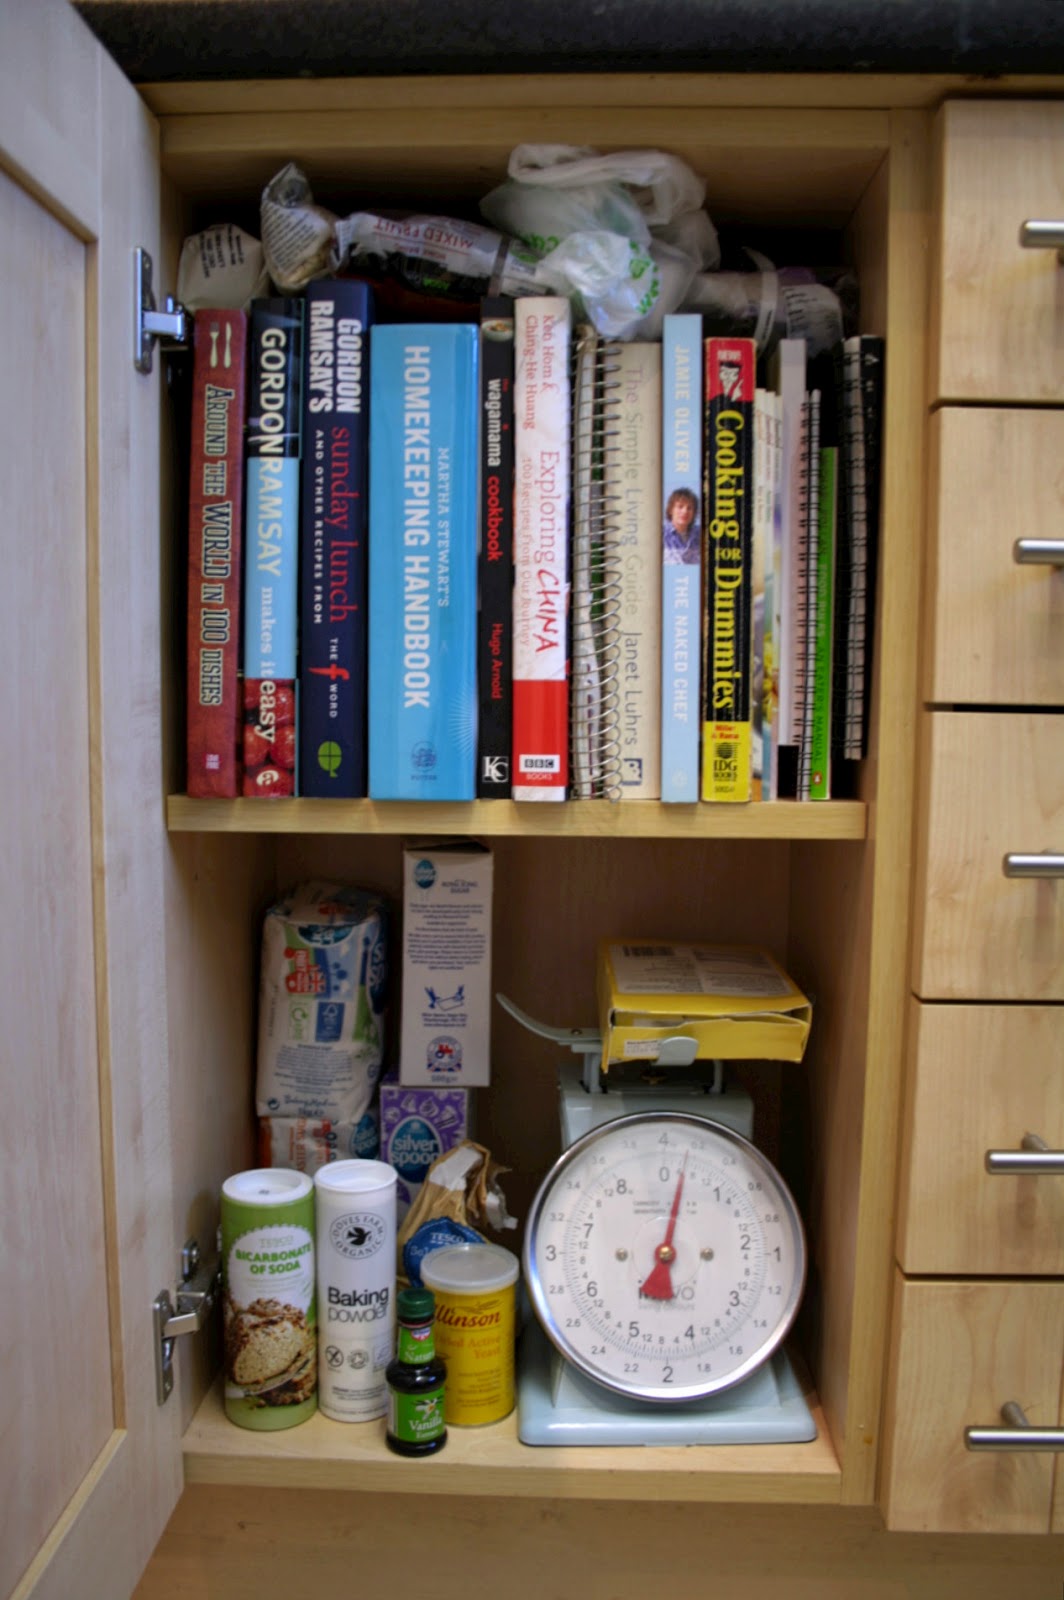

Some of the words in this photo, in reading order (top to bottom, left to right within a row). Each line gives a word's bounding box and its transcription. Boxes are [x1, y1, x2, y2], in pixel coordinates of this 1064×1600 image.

[423, 226, 472, 249] MIXED
[543, 314, 556, 341] Ken
[309, 301, 334, 413] RAMSAY'S
[524, 315, 539, 378] Ching-He
[336, 318, 362, 412] GORDON
[543, 346, 555, 378] Hom
[674, 344, 690, 400] JAMIE
[259, 328, 286, 454] GORDON
[625, 367, 643, 403] The
[523, 384, 538, 430] Huang
[485, 379, 502, 466] wagamama
[315, 429, 324, 460] AND
[404, 346, 431, 546] HOMEKEEPING
[621, 412, 643, 479] Simple
[675, 407, 690, 473] OLIVER
[203, 461, 227, 496] THE
[324, 426, 360, 528] sunday
[437, 448, 450, 514] MARTHA
[709, 409, 745, 540] Cooking
[315, 466, 324, 514] OTHER
[257, 458, 283, 576] RAMSAY
[487, 476, 503, 561] cookbook
[534, 451, 561, 564] Exploring
[621, 488, 643, 547] Living
[201, 501, 233, 578] WORLD
[314, 520, 323, 579] RECIPES
[437, 520, 449, 607] STEWART'S
[715, 548, 741, 560] FOR
[329, 540, 359, 623] lunch
[625, 554, 643, 615] Guide
[675, 576, 689, 609] THE
[202, 583, 224, 603] IN
[314, 586, 323, 624] FROM
[533, 569, 561, 652] CHINA
[201, 609, 230, 643] 100
[259, 586, 277, 653] makes
[403, 555, 430, 708] HANDBOOK
[489, 623, 503, 655] Hugo
[712, 566, 743, 709] Dummies
[329, 638, 338, 660] THE
[674, 616, 689, 672] NAKED
[622, 632, 643, 682] Janet
[200, 648, 223, 705] DISHES
[260, 661, 275, 677] it
[308, 663, 349, 680] f
[491, 659, 503, 699] Arnold
[255, 680, 276, 742] easy
[329, 684, 338, 718] WORD
[673, 678, 689, 722] CHEF
[625, 691, 643, 745] Luhrs
[525, 759, 554, 768] BBC
[714, 760, 738, 771] IDG
[394, 1134, 438, 1151] silver
[658, 1132, 669, 1146] 4
[659, 1166, 670, 1182] 0
[604, 1188, 613, 1197] 12
[616, 1178, 627, 1194] 8
[713, 1186, 720, 1202] 1
[726, 1197, 732, 1205] 4
[333, 1216, 360, 1237] DOVES
[363, 1216, 384, 1234] FARM
[550, 1213, 565, 1221] 3.2
[738, 1223, 748, 1232] 12
[583, 1223, 593, 1239] 7
[740, 1234, 751, 1250] 2
[235, 1242, 311, 1262] BICARBONATE
[336, 1240, 381, 1257] ORGANIC
[545, 1244, 556, 1261] 3
[578, 1241, 588, 1249] 12
[773, 1246, 781, 1262] 1
[250, 1264, 266, 1275] OF
[268, 1260, 300, 1275] SODA
[328, 1286, 389, 1307] Baking
[549, 1285, 564, 1294] 2.8
[587, 1281, 598, 1297] 6
[738, 1282, 748, 1290] 12
[768, 1286, 782, 1295] 1.2
[593, 1299, 604, 1308] 12
[729, 1290, 740, 1307] 3
[435, 1304, 500, 1327] llinson
[565, 1318, 581, 1328] 2.6
[725, 1308, 731, 1316] 4
[629, 1321, 640, 1338] 5
[684, 1325, 695, 1340] 4
[701, 1327, 711, 1335] 12
[753, 1319, 767, 1328] 1.4
[642, 1334, 652, 1342] 12
[658, 1336, 664, 1344] 8
[673, 1336, 679, 1344] 4
[591, 1346, 606, 1355] 2.4
[729, 1346, 743, 1355] 1.6
[624, 1363, 639, 1372] 2.2
[662, 1365, 674, 1383] 2
[697, 1363, 711, 1372] 1.8
